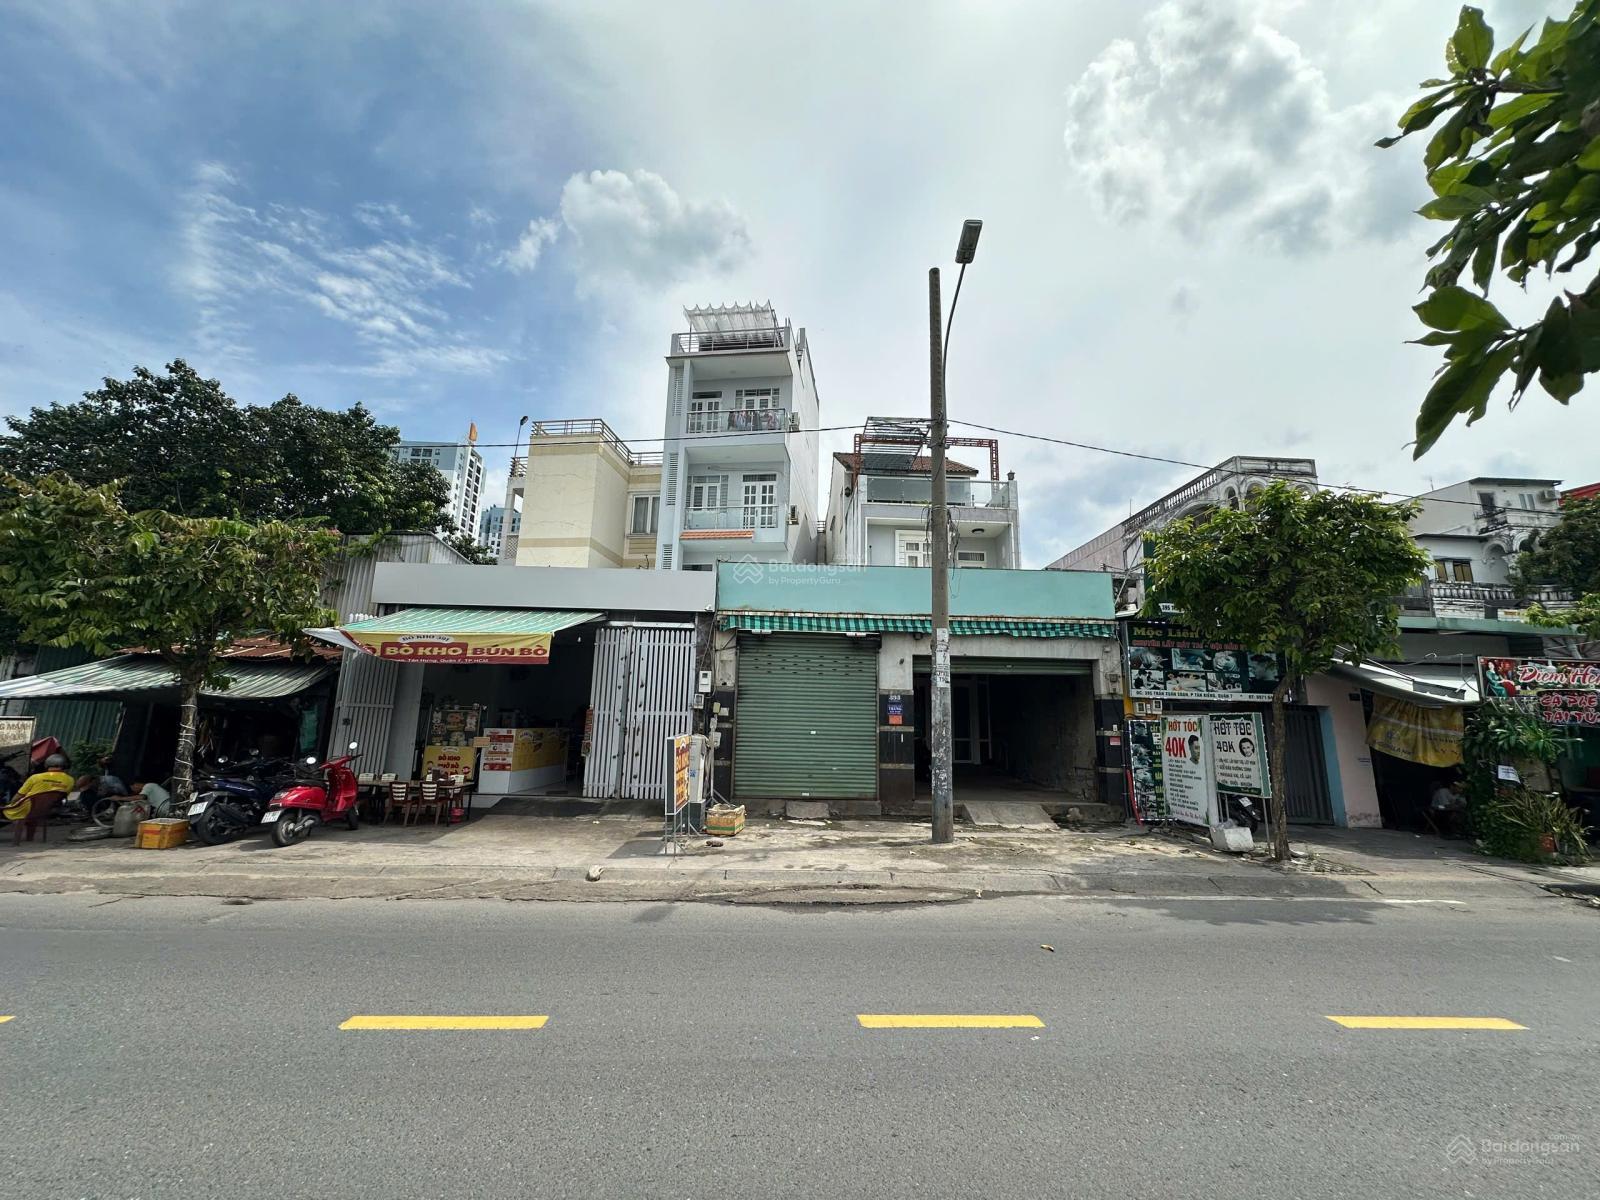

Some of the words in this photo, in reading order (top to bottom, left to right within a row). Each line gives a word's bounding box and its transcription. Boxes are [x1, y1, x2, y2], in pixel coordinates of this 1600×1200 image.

[384, 643, 415, 656] BÒ
[417, 646, 463, 656] KHO
[472, 644, 515, 656] BÚN
[519, 644, 548, 656] BÒ
[1168, 718, 1182, 732] HỚT
[1183, 718, 1198, 732] TÓC
[1213, 719, 1232, 736] HỚT
[1233, 719, 1252, 736] TÓC
[1165, 736, 1187, 758] 40K
[1216, 740, 1236, 753] 40K
